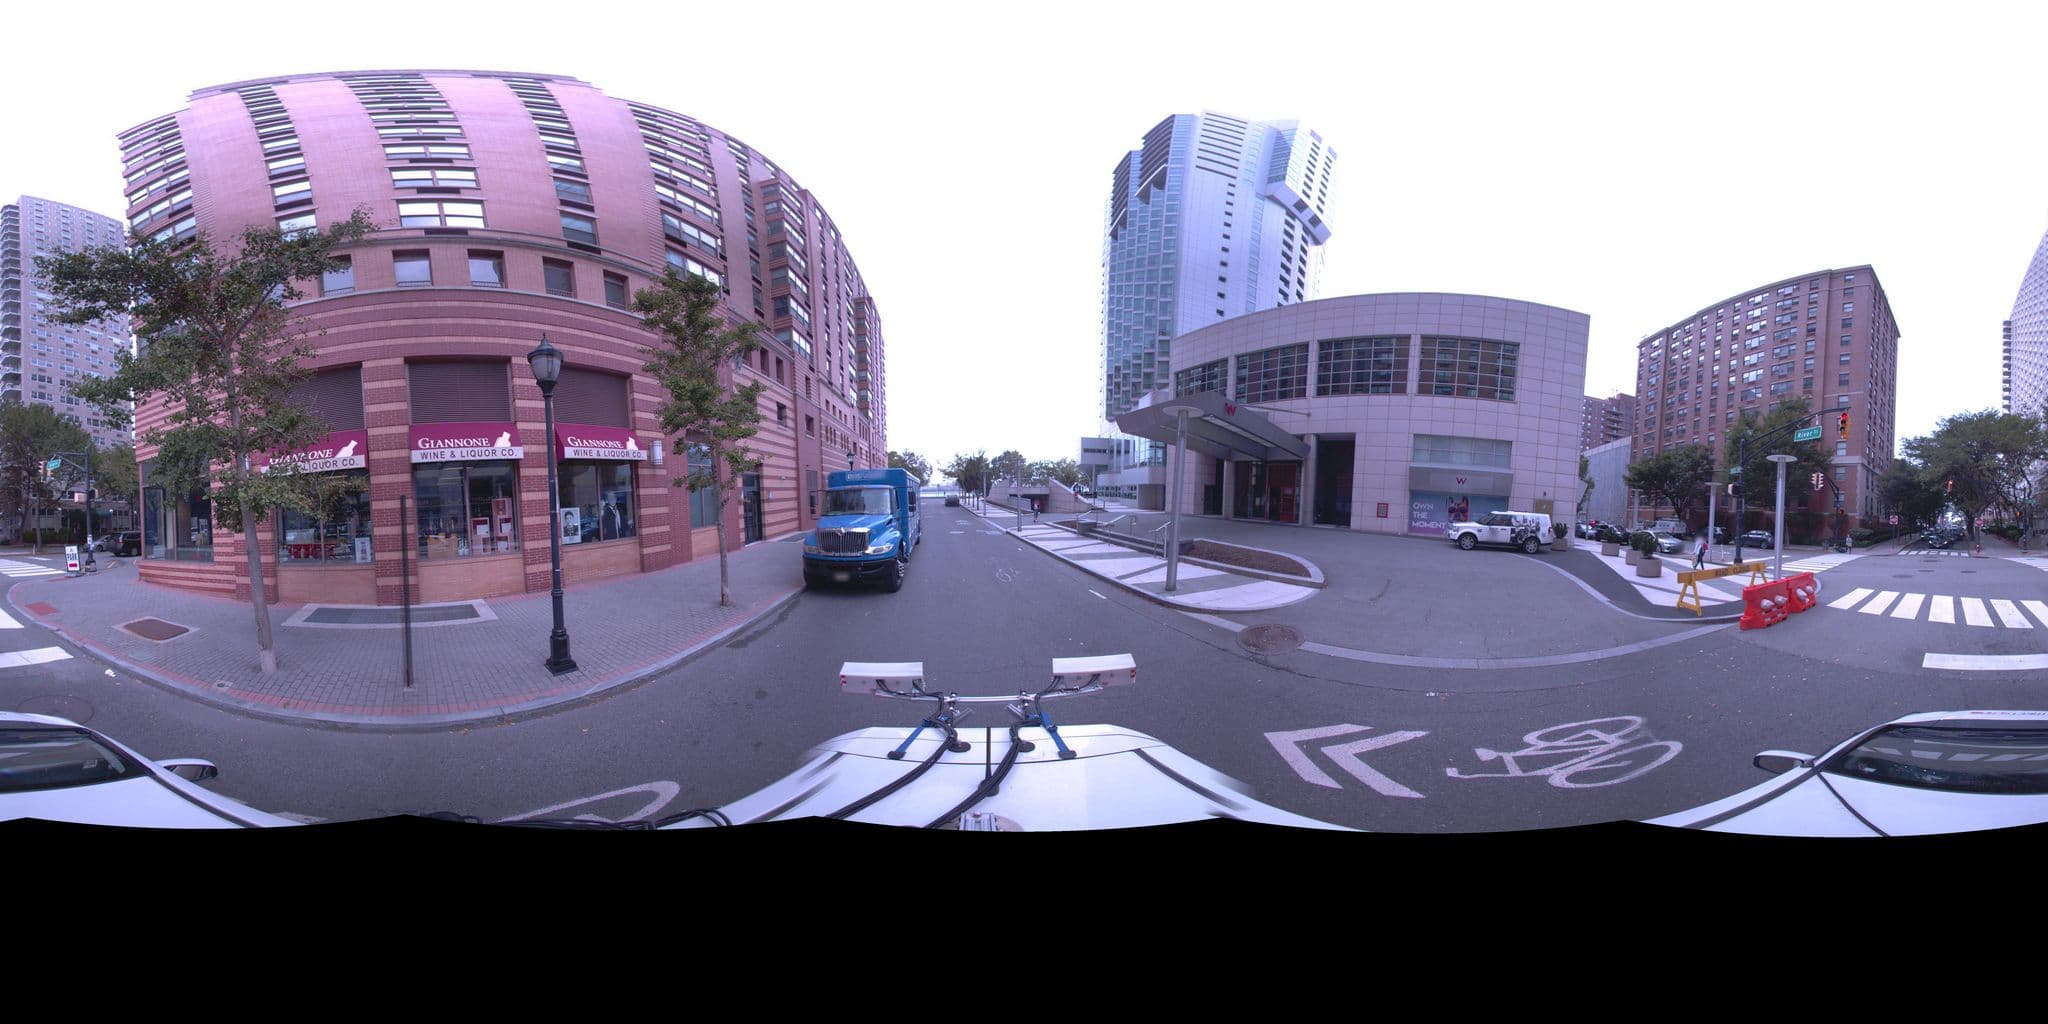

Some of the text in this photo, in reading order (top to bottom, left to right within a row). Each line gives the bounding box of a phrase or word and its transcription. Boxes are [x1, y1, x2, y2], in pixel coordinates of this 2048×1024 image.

[1797, 431, 1813, 439] River
[418, 437, 490, 449] GIANNONE
[567, 436, 624, 449] GIANNONE
[421, 448, 517, 460] WINE & LIQUOR CO.
[574, 449, 593, 457] WINE
[604, 449, 630, 457] LIQUOR
[342, 457, 359, 466] CO.
[1456, 476, 1467, 485] W
[1412, 502, 1434, 510] OWN
[1413, 511, 1428, 519] THE
[1411, 520, 1446, 529] MOMENT
